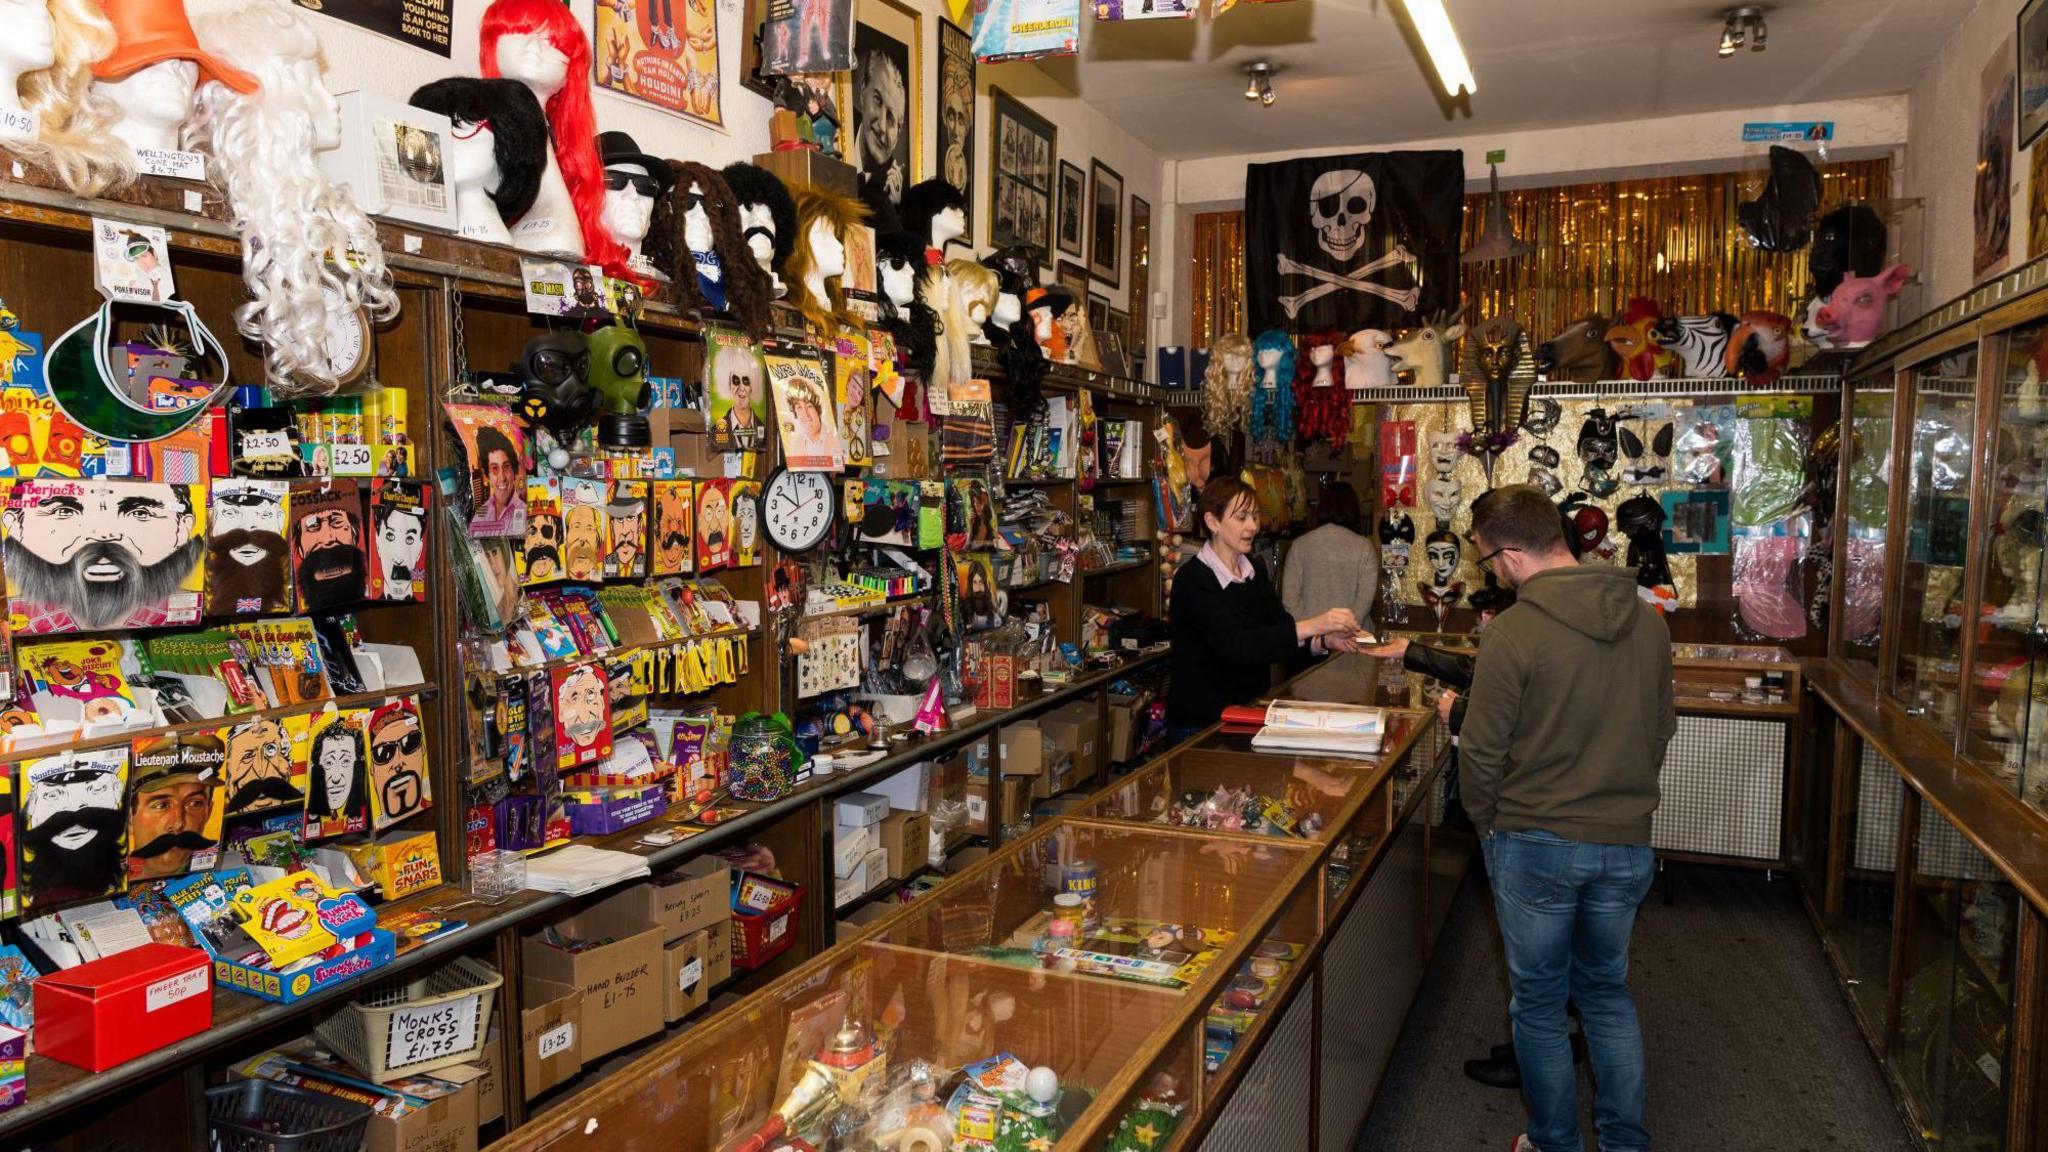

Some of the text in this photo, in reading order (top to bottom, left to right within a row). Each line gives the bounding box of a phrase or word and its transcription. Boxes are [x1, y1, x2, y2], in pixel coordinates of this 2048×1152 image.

[403, 2, 449, 24] YOUR MIND
[402, 13, 448, 34] IS AN OPEN
[1010, 15, 1073, 33] CHEERLEADER
[401, 23, 448, 46] BOOK TO HER
[641, 66, 675, 82] CAN HOLD
[640, 74, 681, 99] HOUDINI
[172, 160, 189, 170] HAT
[114, 286, 151, 296] POKER VISOR
[530, 281, 565, 296] GAS MASK
[245, 437, 280, 450] £2.50
[334, 449, 370, 466] £2.50
[797, 473, 806, 485] 12
[808, 477, 815, 488] 11
[0, 482, 85, 499] Lumberjack's
[259, 488, 282, 500] Beard
[776, 485, 783, 497] 2
[814, 488, 823, 499] 10
[0, 498, 40, 509] Beard
[290, 490, 341, 507] COSSACK
[771, 499, 778, 510] 3
[817, 502, 823, 513] 9
[773, 514, 779, 524] 4
[812, 516, 818, 527] 8
[780, 525, 787, 536] 5
[791, 528, 797, 540] 6
[803, 526, 809, 536] 7
[81, 657, 102, 666] JOKE
[135, 751, 225, 768] Lieutenant Moustache
[30, 760, 119, 782] Nautical Beard
[402, 858, 428, 874] FUN
[189, 875, 214, 892] MOUTH
[394, 867, 439, 890] SNAPS
[1067, 878, 1097, 892] KING
[174, 890, 202, 908] SWEETS
[183, 968, 205, 983] TRAP
[586, 963, 649, 996] HAND BUZZER
[398, 1007, 454, 1030] MONKS
[404, 1020, 458, 1043] CROSS
